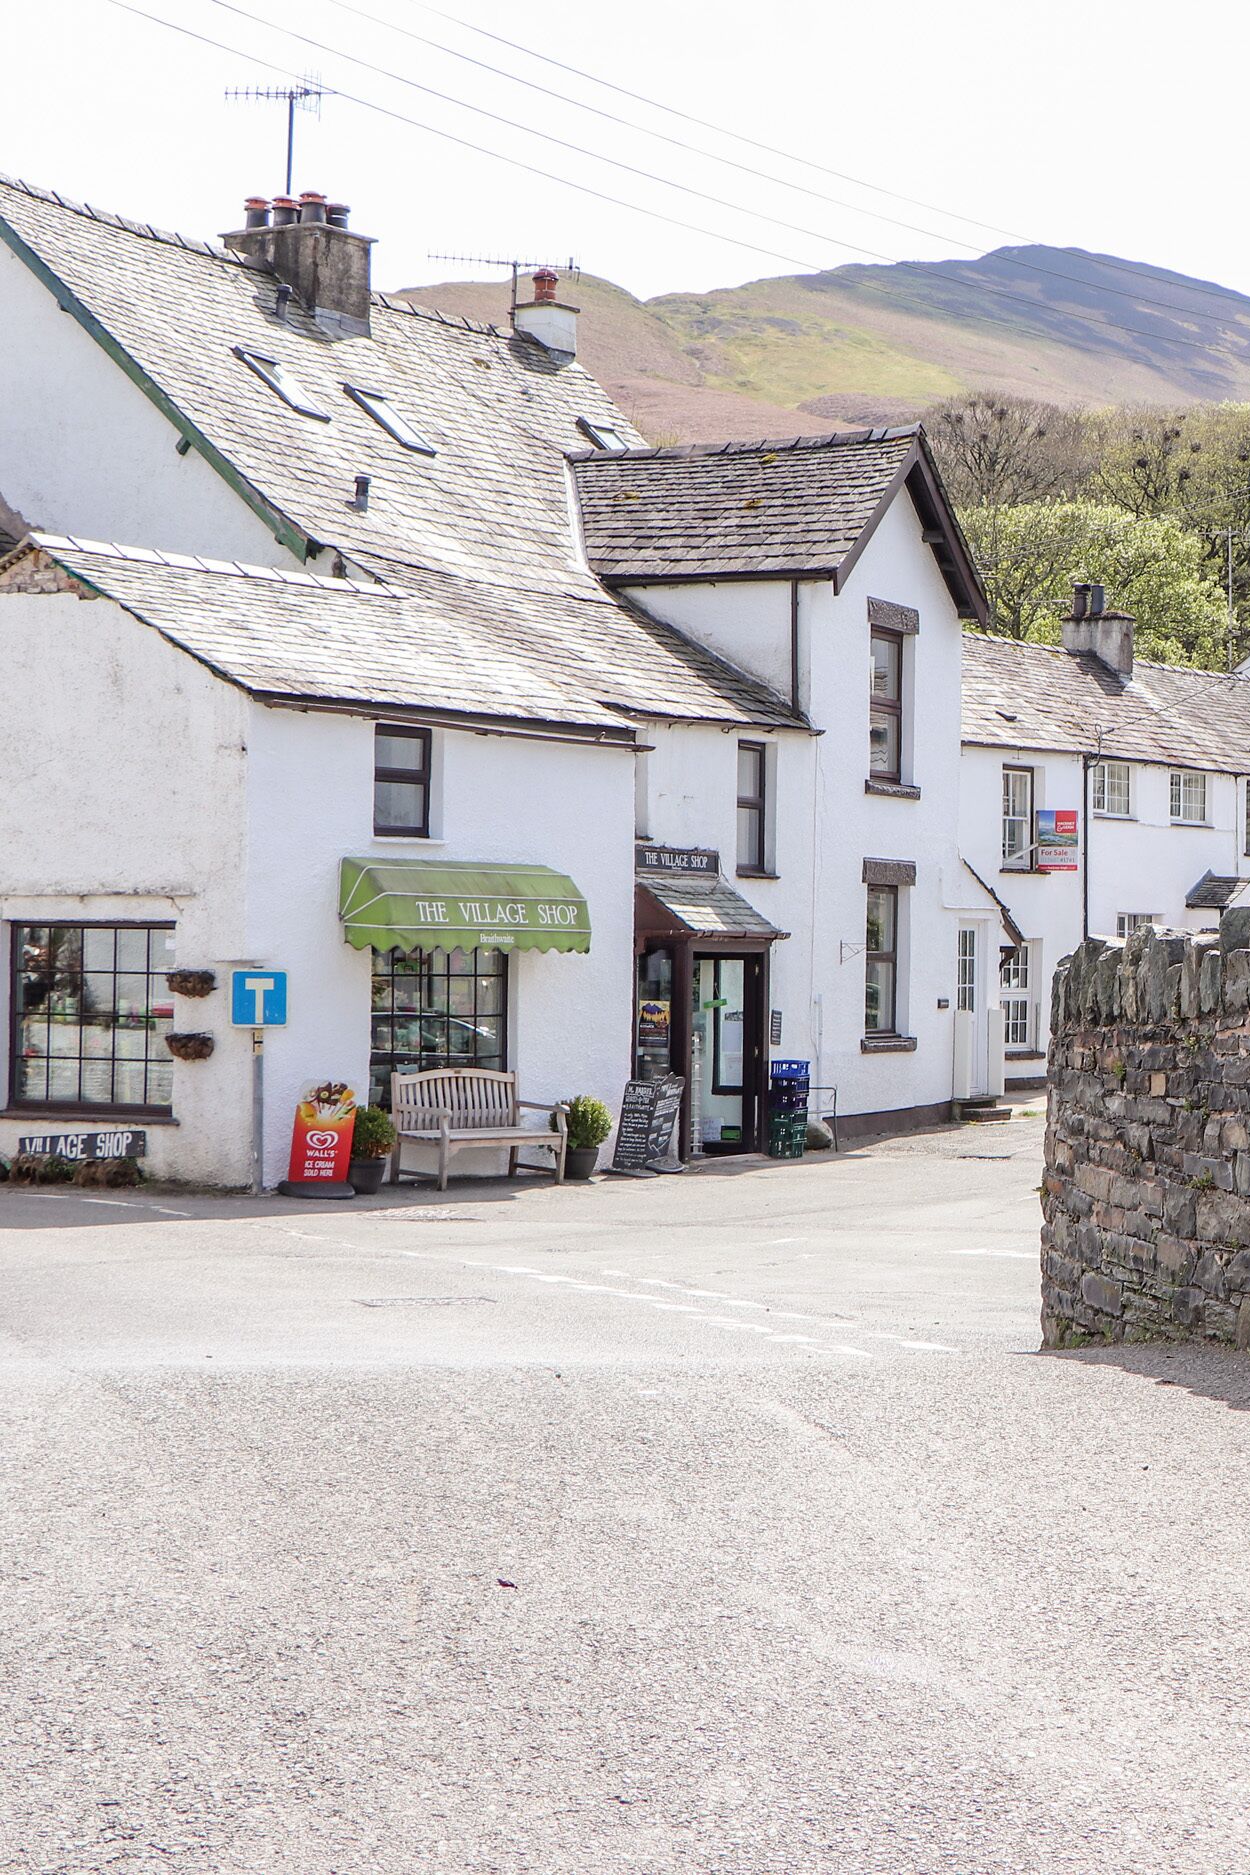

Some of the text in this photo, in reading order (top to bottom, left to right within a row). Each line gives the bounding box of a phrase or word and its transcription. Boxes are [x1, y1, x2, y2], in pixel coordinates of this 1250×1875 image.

[645, 852, 708, 868] THE VILLAGE SHOP
[416, 901, 578, 925] THE VILLAGE SHOP
[480, 933, 515, 944] Braithwaite
[96, 1132, 133, 1157] SHOP
